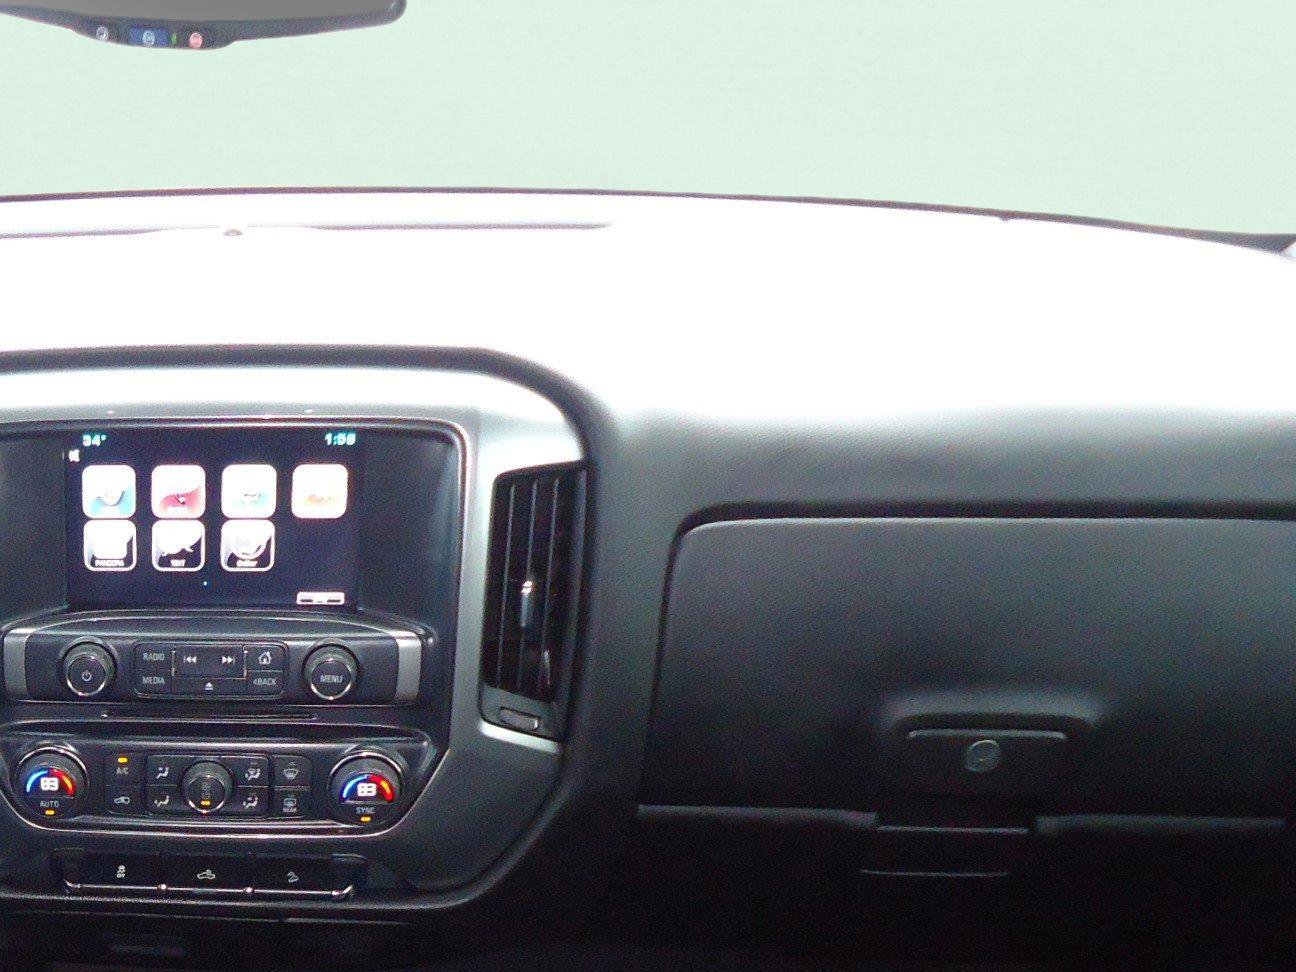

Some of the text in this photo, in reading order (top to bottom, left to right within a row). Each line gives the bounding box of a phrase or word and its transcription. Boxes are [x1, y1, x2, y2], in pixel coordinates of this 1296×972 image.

[142, 651, 166, 662] RADIO
[142, 675, 166, 685] MEDIA
[258, 678, 277, 687] BACK
[319, 673, 344, 684] MENU
[115, 766, 130, 775] A/C
[39, 800, 60, 808] AUTO
[355, 806, 375, 815] SYNC
